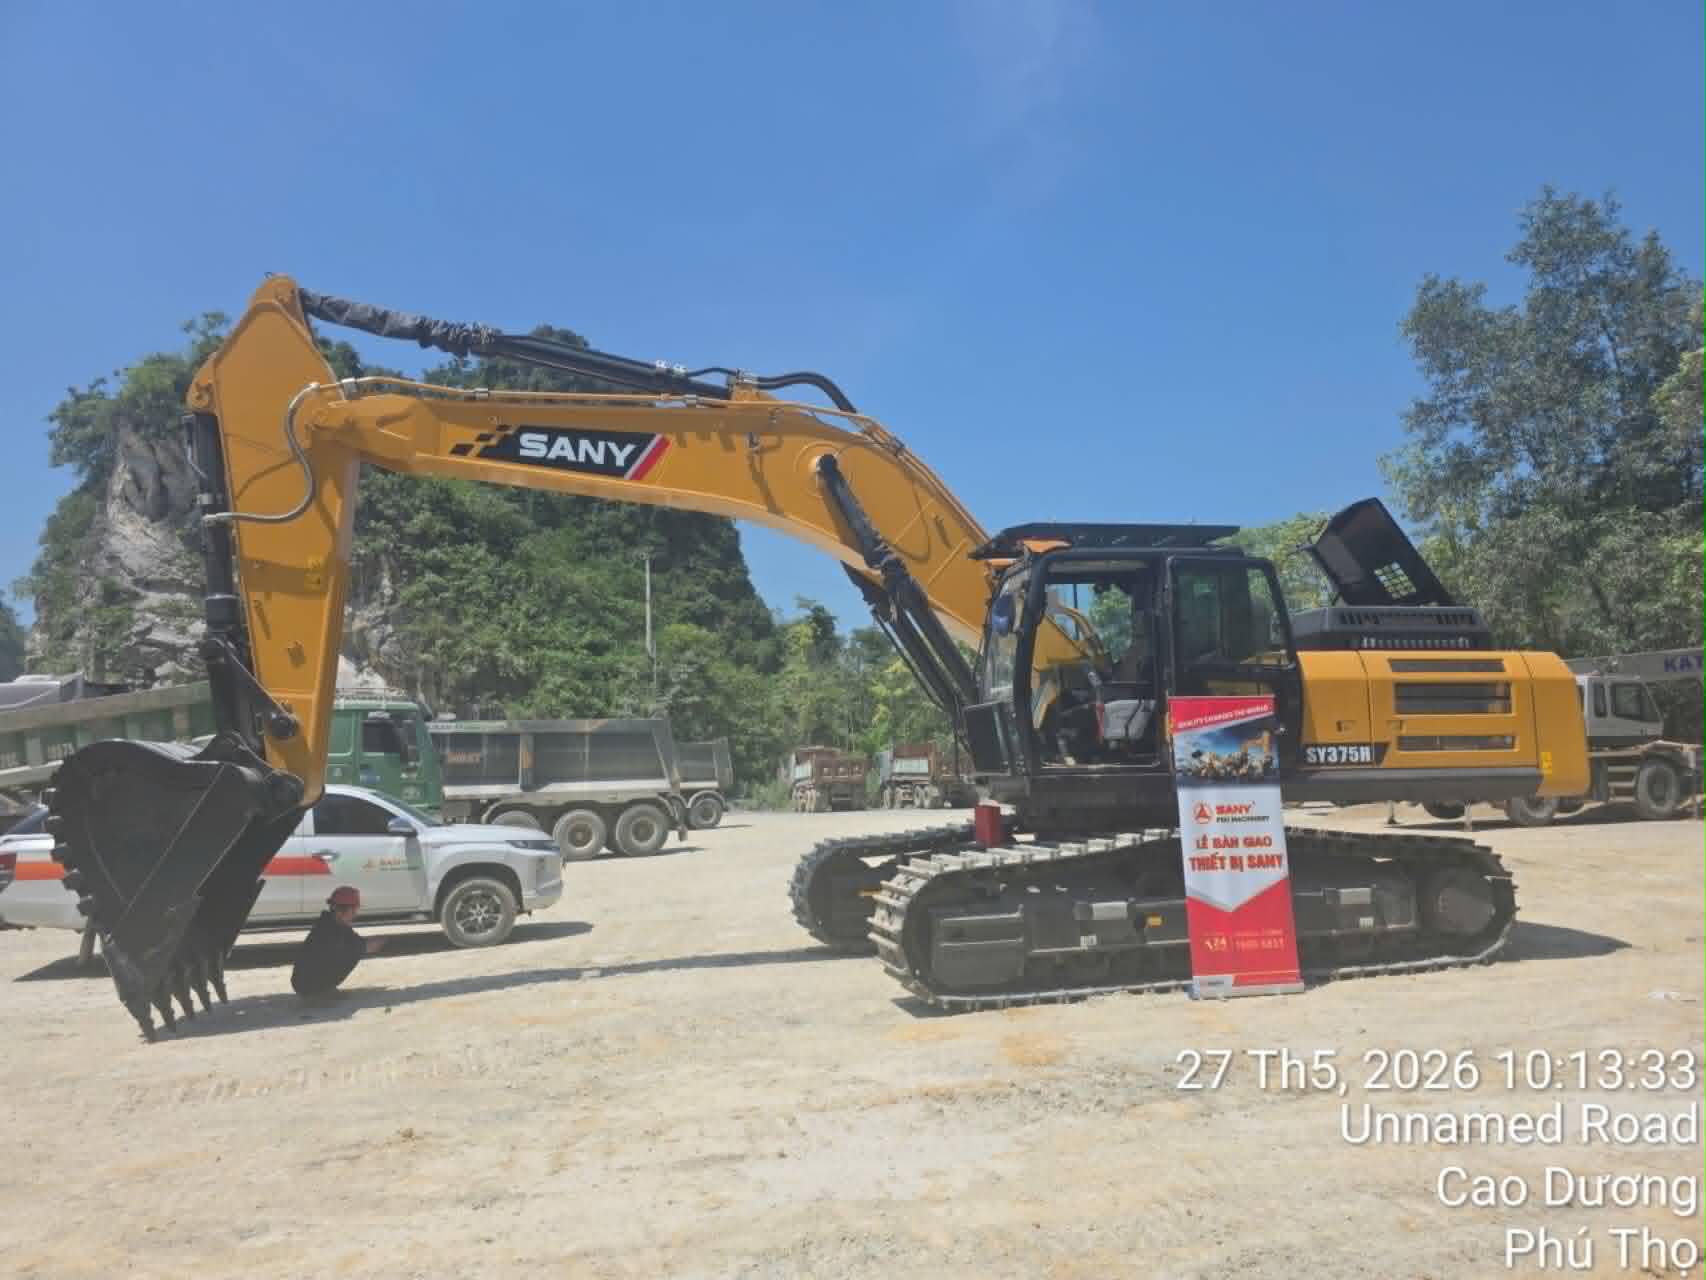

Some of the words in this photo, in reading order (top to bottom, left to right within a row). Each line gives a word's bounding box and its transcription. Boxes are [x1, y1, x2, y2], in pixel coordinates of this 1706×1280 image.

[519, 433, 636, 467] SANY
[1216, 804, 1250, 815] SANY
[1243, 836, 1273, 848] GIAO
[1248, 854, 1282, 869] SANY
